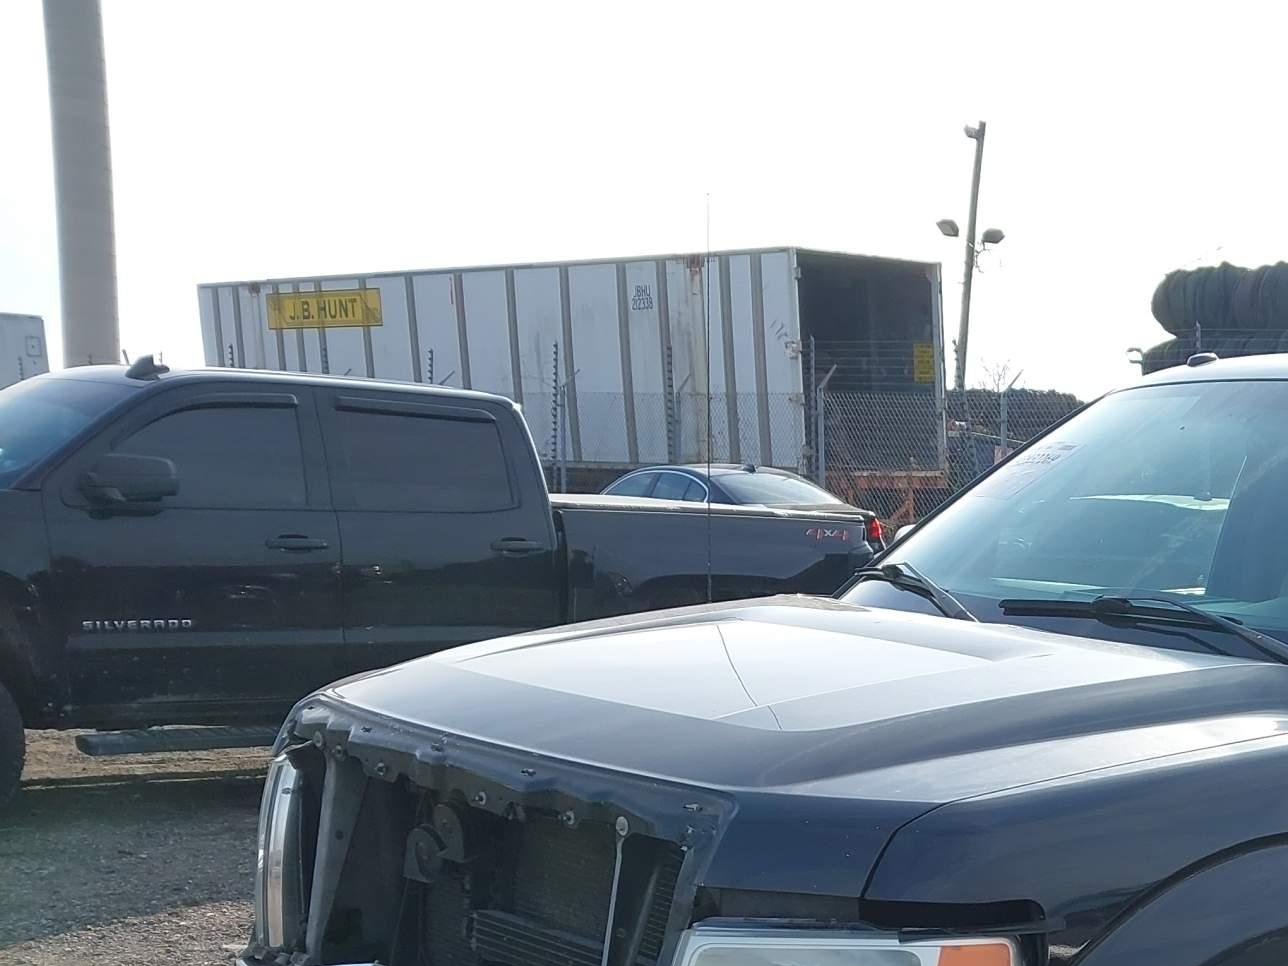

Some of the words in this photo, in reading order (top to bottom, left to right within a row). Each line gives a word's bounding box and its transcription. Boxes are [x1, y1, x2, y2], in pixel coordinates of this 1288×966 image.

[633, 284, 651, 297] JBHU
[317, 298, 357, 319] HUNT
[82, 619, 192, 631] SILVERADO
